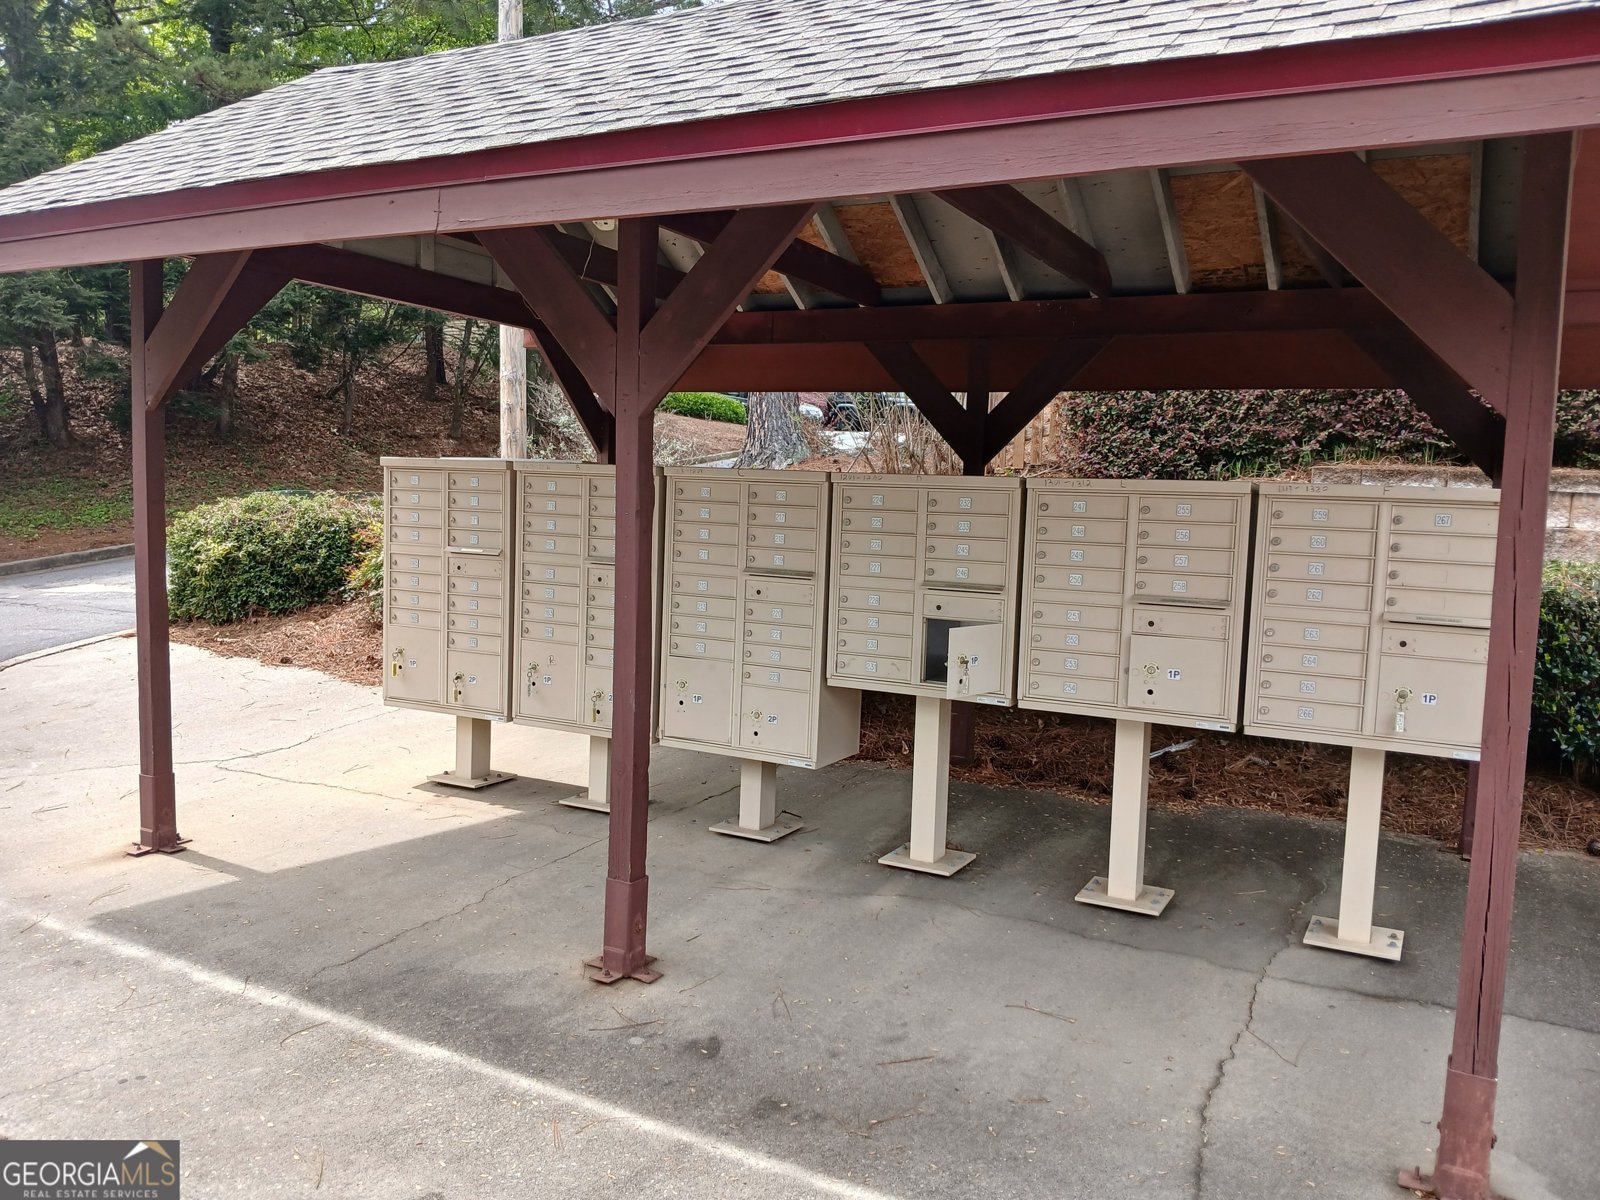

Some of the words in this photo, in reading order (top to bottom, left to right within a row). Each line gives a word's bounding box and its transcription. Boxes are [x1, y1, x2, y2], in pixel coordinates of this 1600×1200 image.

[1072, 502, 1086, 512] 247
[1177, 505, 1191, 516] 255
[1313, 509, 1328, 520] 259
[1436, 515, 1450, 525] 267
[1175, 530, 1189, 541] 256
[1311, 536, 1326, 547] 260
[1070, 550, 1083, 561] 249
[1174, 555, 1188, 566] 257
[1309, 563, 1323, 574] 261
[1172, 581, 1186, 592] 258
[1307, 590, 1321, 601] 262
[1305, 629, 1319, 640] 263
[1303, 655, 1317, 666] 264
[1063, 682, 1076, 693] 254
[1300, 682, 1315, 693] 265
[1422, 695, 1436, 703] 1P
[1299, 708, 1313, 719] 266
